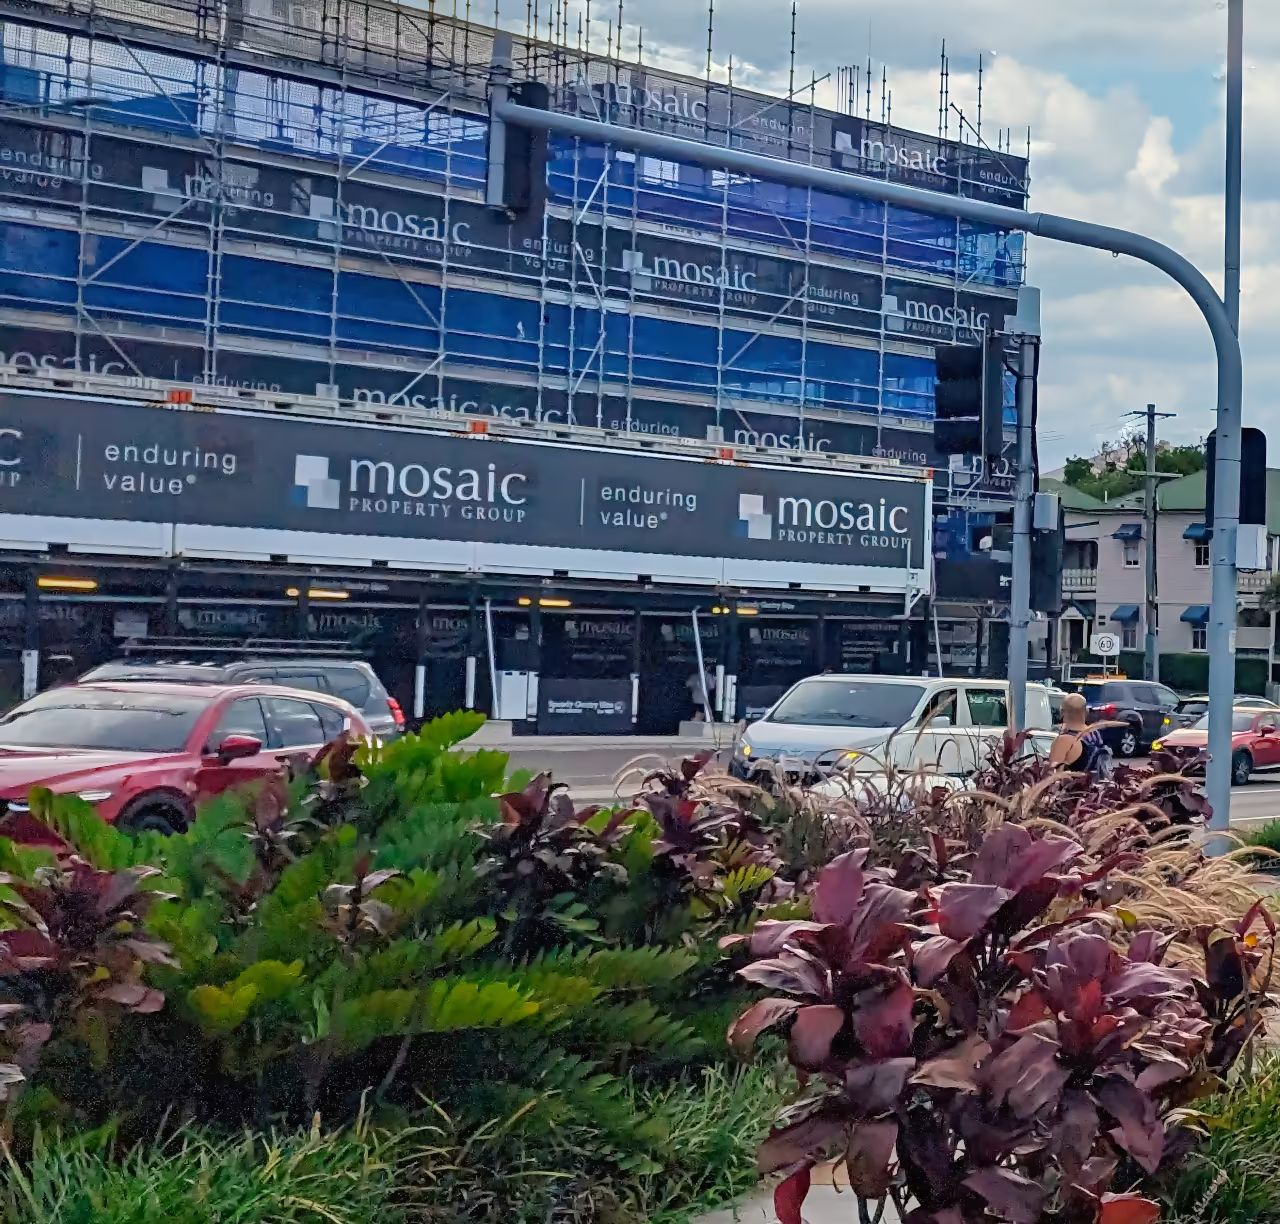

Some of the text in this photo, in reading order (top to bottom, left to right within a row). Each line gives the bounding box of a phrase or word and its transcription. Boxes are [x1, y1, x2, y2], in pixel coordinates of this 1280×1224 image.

[349, 203, 471, 244] mosac
[654, 256, 757, 291] mosaic
[718, 291, 757, 304] ROUP
[803, 285, 860, 305] nduring
[803, 301, 837, 315] alue
[734, 429, 832, 454] mosaic
[105, 443, 237, 475] enduring
[350, 459, 527, 505] mosaic
[350, 498, 526, 523] PROPERTY GROUP
[601, 486, 697, 512] enduring
[778, 497, 909, 534] mosaic
[778, 530, 910, 549] PROPERTY GROUP
[1101, 640, 1112, 649] 60
